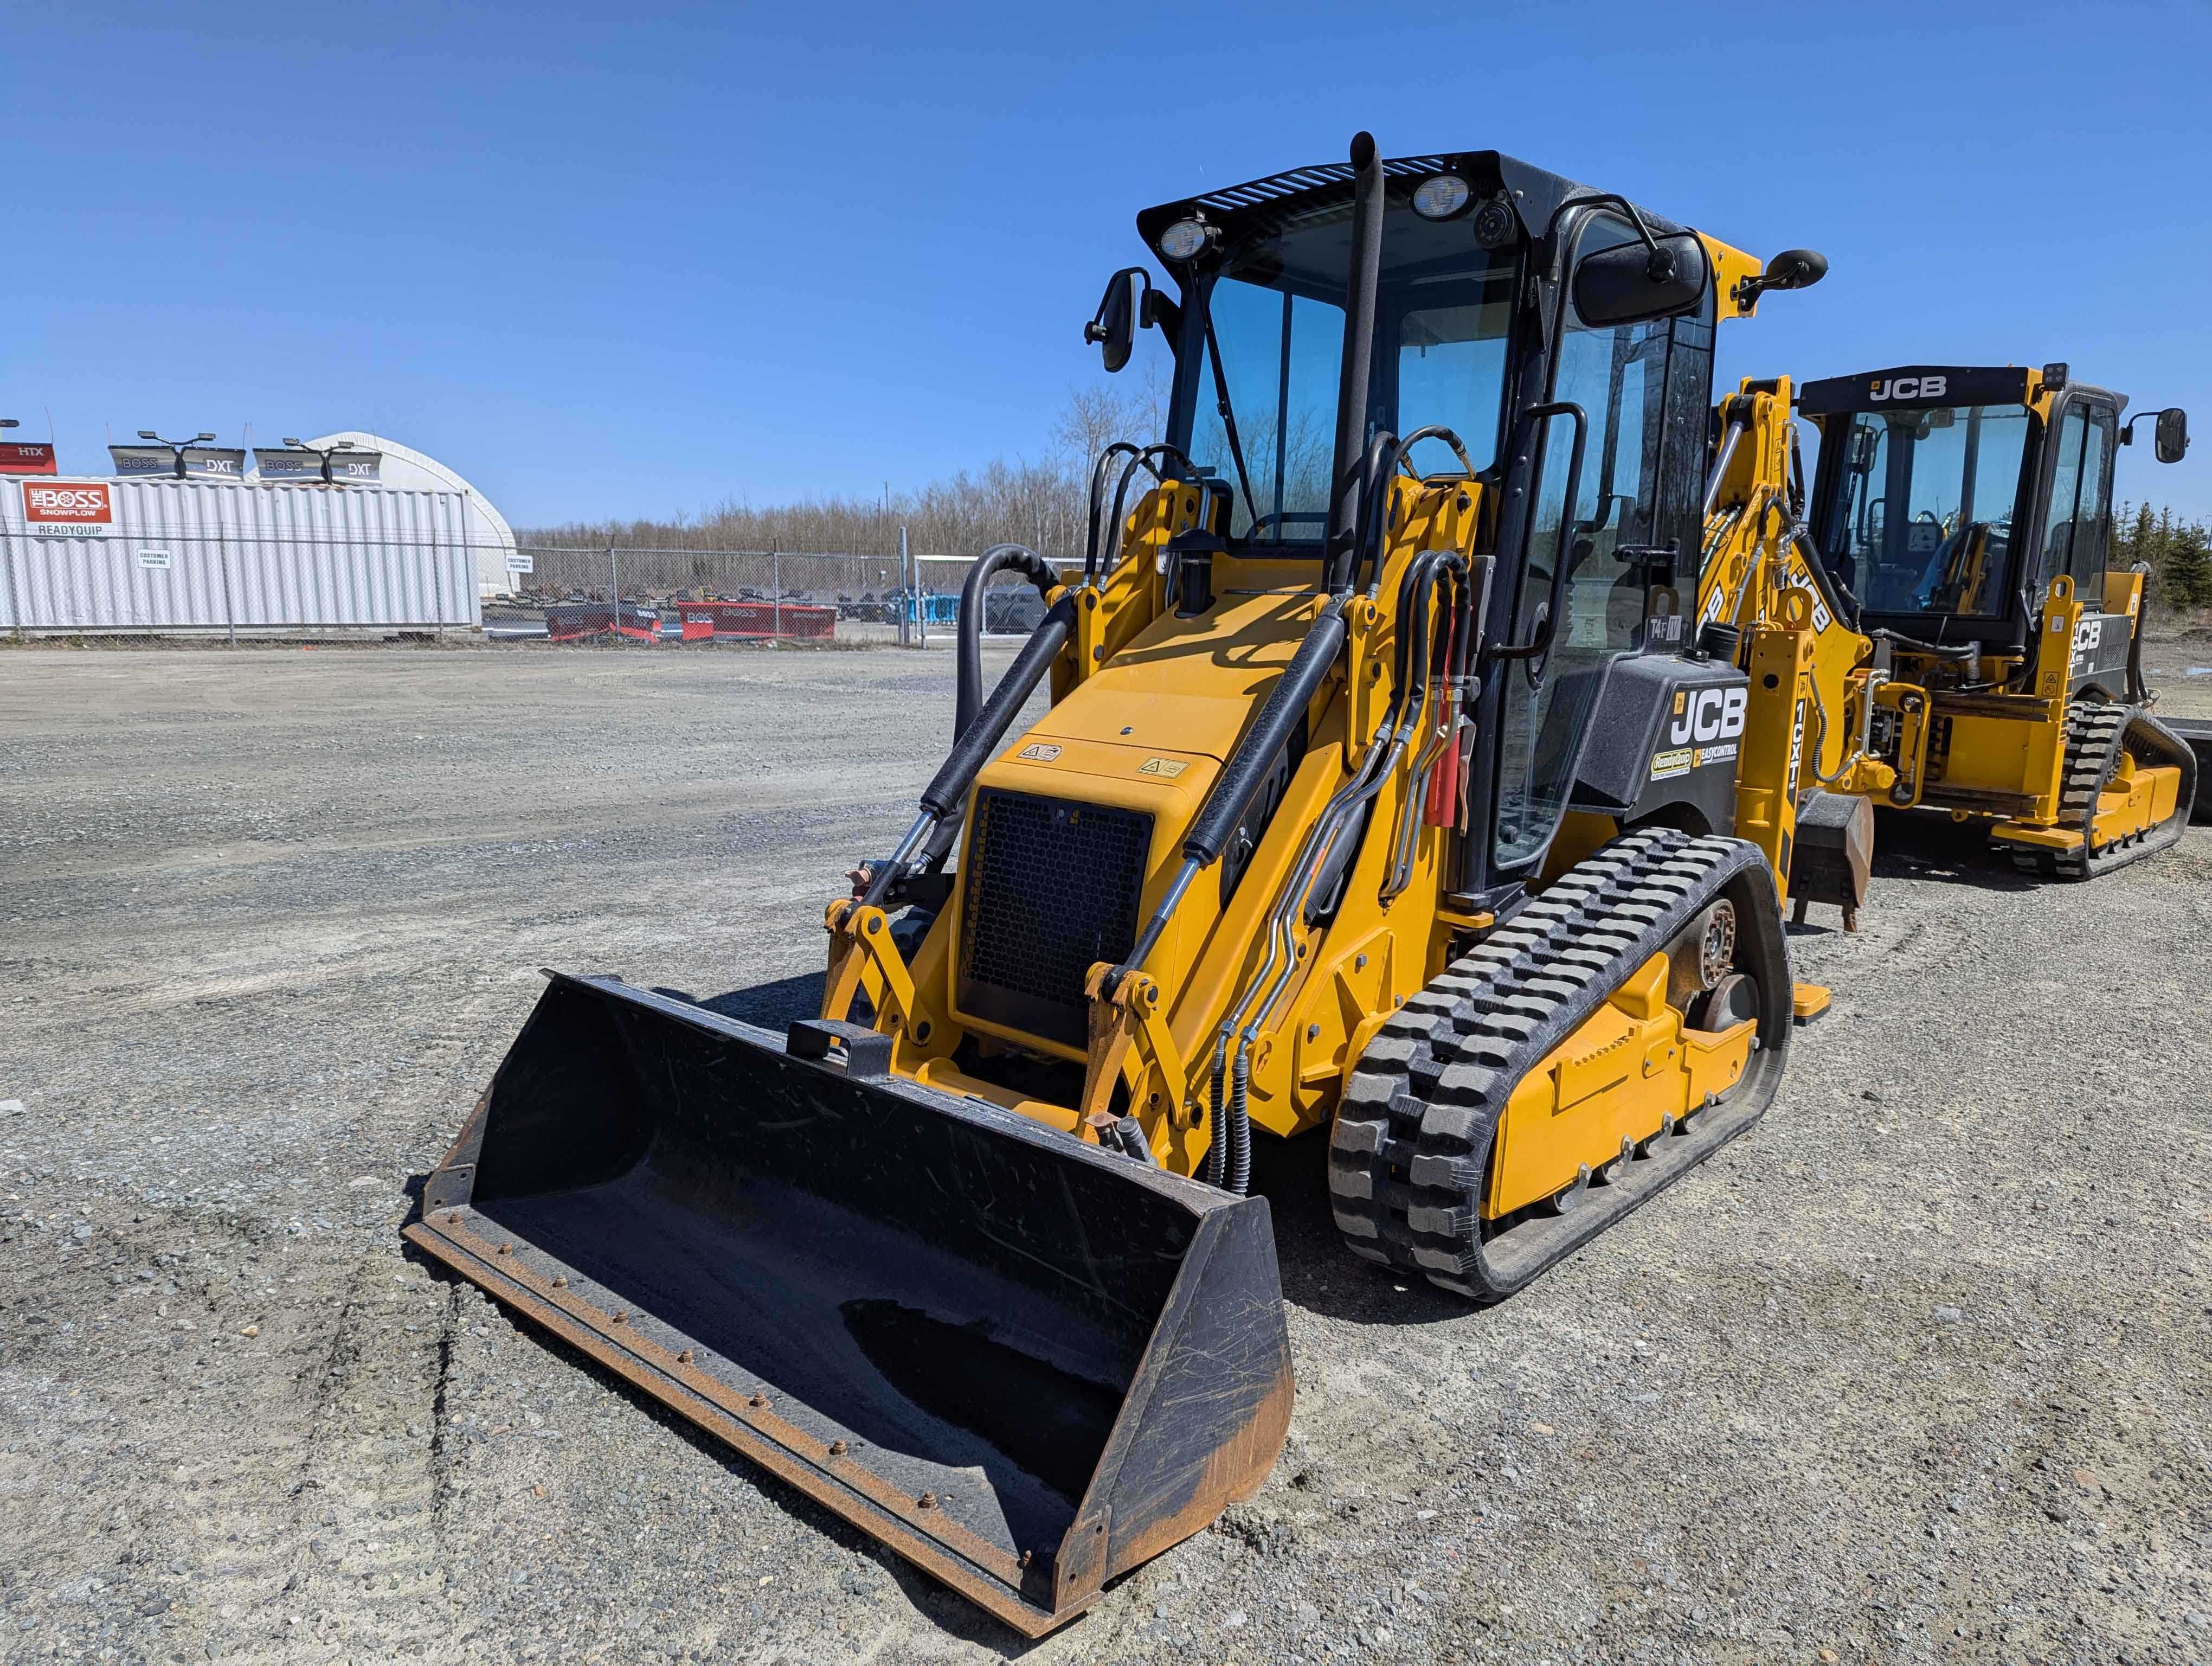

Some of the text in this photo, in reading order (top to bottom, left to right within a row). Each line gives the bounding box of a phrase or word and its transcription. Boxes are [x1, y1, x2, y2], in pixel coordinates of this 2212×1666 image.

[1870, 376, 1947, 401] JCB
[17, 447, 44, 456] HTX
[122, 458, 158, 468] BOSS
[205, 459, 234, 472] DXT
[265, 460, 304, 471] BOSS
[348, 463, 372, 475] DXT
[31, 490, 102, 508] THE BOSS
[38, 525, 102, 535] READYQUIP
[636, 608, 657, 618] BOSS
[1650, 618, 1680, 639] T4F IV
[2076, 620, 2102, 651] CB
[2068, 621, 2079, 677] 1CXT
[1670, 687, 1748, 745] JCB
[1790, 701, 1804, 781] 1CXT
[1655, 751, 1690, 768] ReadyQuip
